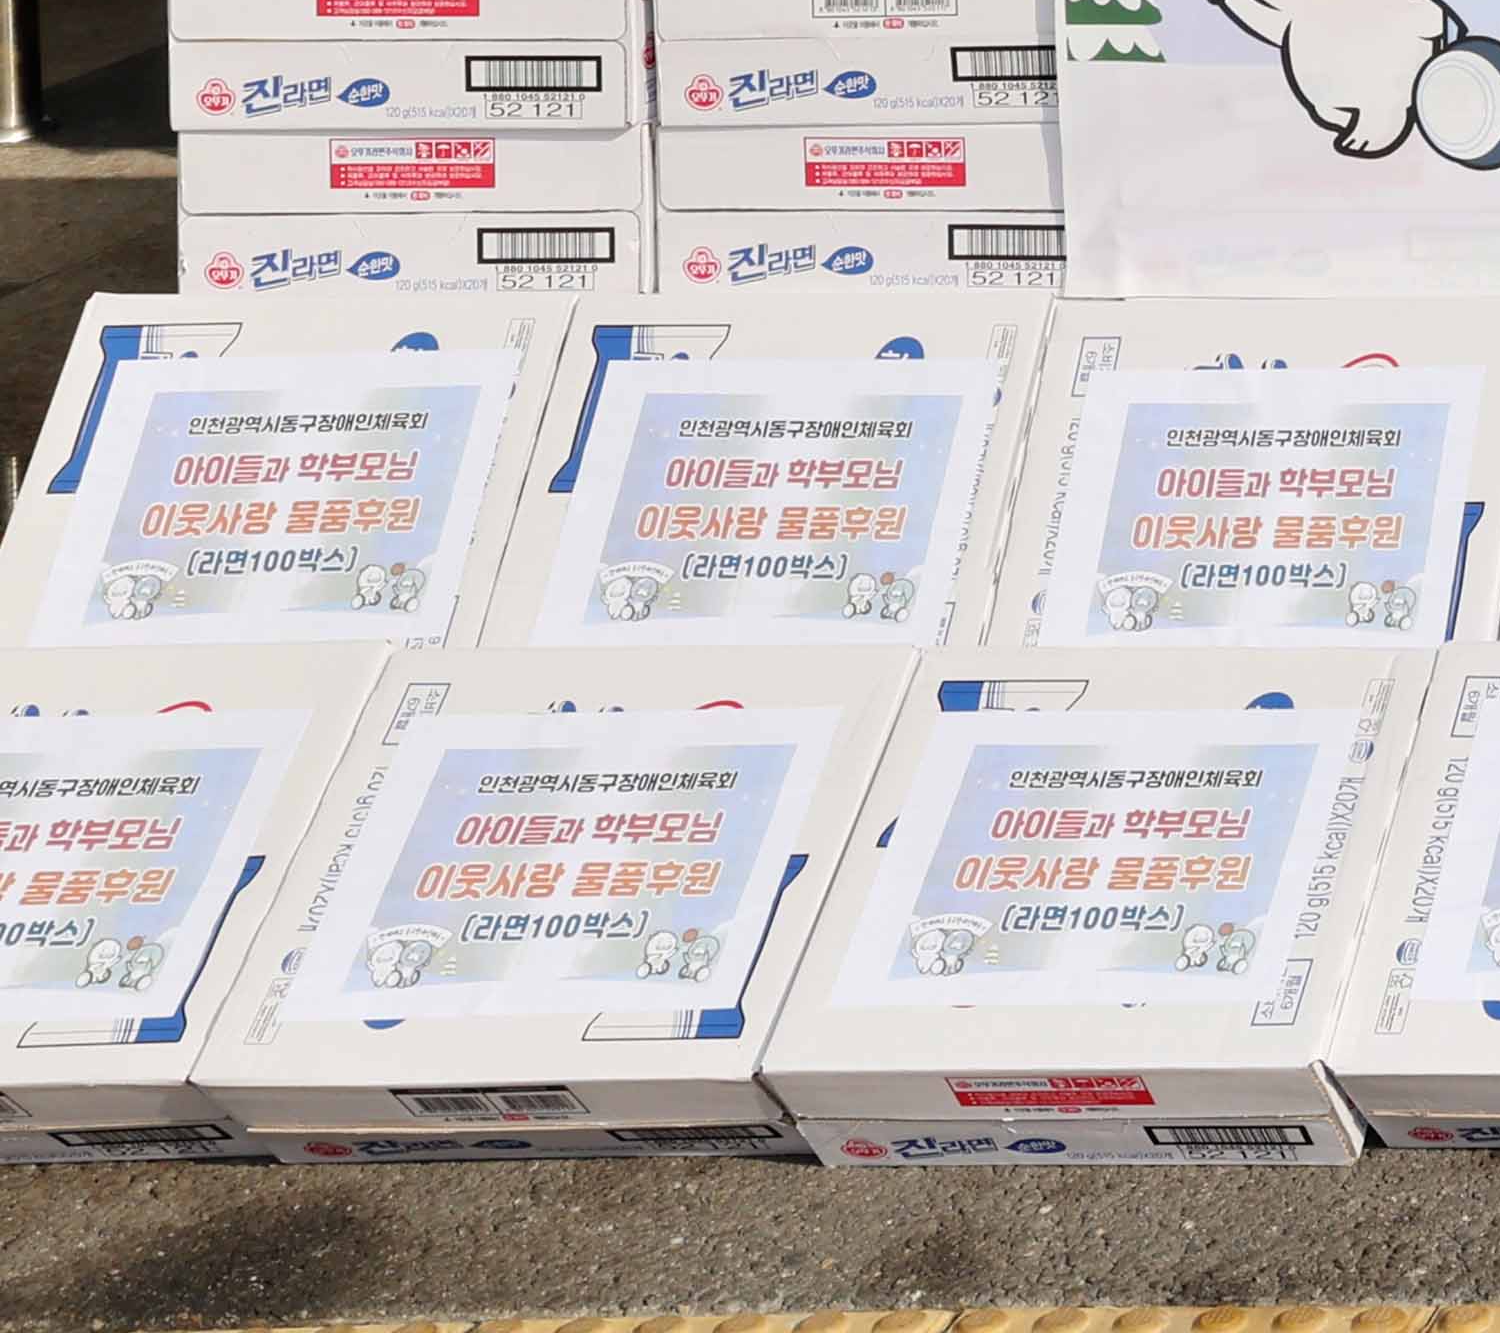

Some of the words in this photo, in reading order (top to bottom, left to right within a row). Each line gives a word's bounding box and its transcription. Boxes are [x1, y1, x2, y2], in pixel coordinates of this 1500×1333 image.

[241, 75, 332, 119] 진라면
[348, 83, 384, 103] 순한맛
[489, 102, 523, 117] 52
[533, 102, 577, 117] 121
[189, 413, 429, 435] 인천광역시동구장애인체육회
[174, 455, 290, 485] 아이들과
[297, 451, 418, 484] 학부모님
[138, 501, 277, 539] 이웃사랑
[285, 498, 420, 533] 물품후원
[478, 771, 738, 793] 인천광역시동구장애인체육회
[456, 816, 584, 845] 아이들과
[592, 812, 723, 844] 학부모님
[412, 862, 565, 901] 이웃사랑
[572, 861, 721, 896] 물품후원
